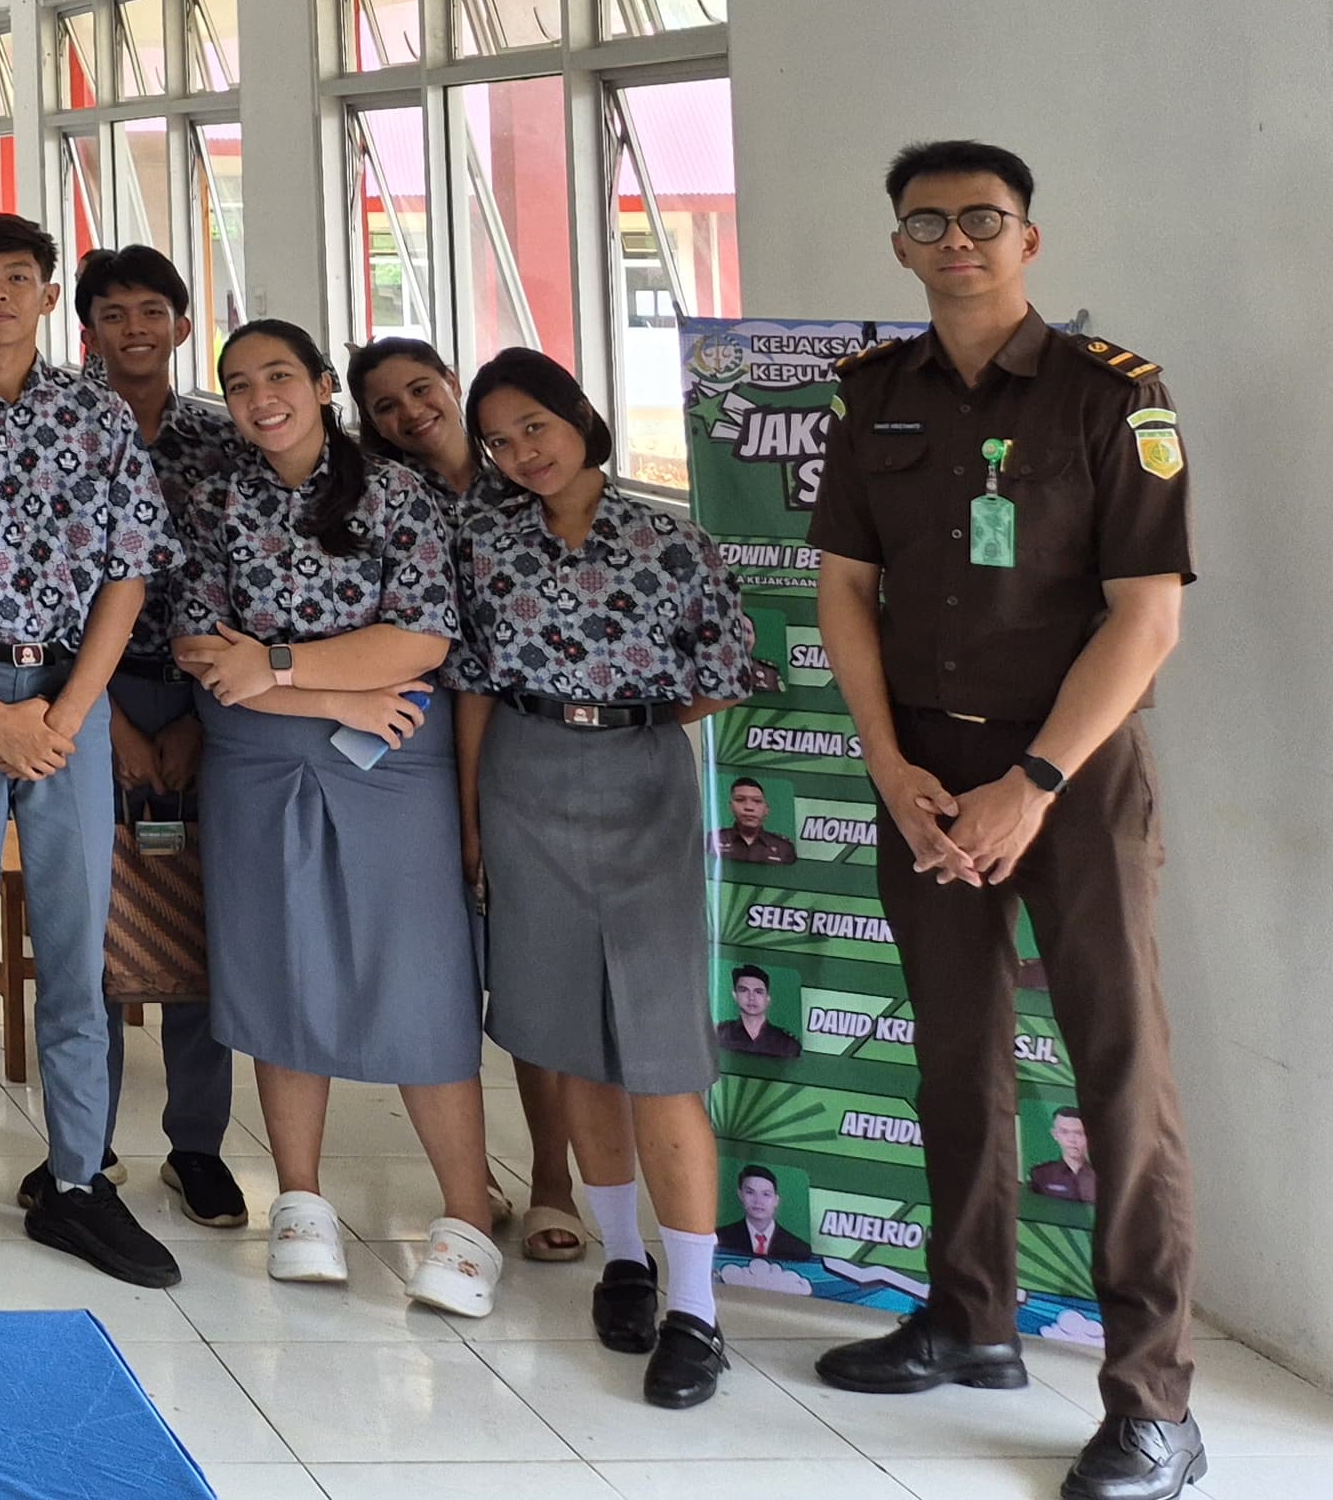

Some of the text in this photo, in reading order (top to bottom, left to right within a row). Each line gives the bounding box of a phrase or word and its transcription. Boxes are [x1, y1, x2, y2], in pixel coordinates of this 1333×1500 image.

[747, 576, 817, 588] KEJAKSAAN
[747, 727, 843, 757] DESLIANA
[748, 905, 809, 932] SELES
[808, 1008, 873, 1037] DAVID
[1013, 1034, 1059, 1064] S.H.
[820, 1211, 923, 1248] ANJELRIO
